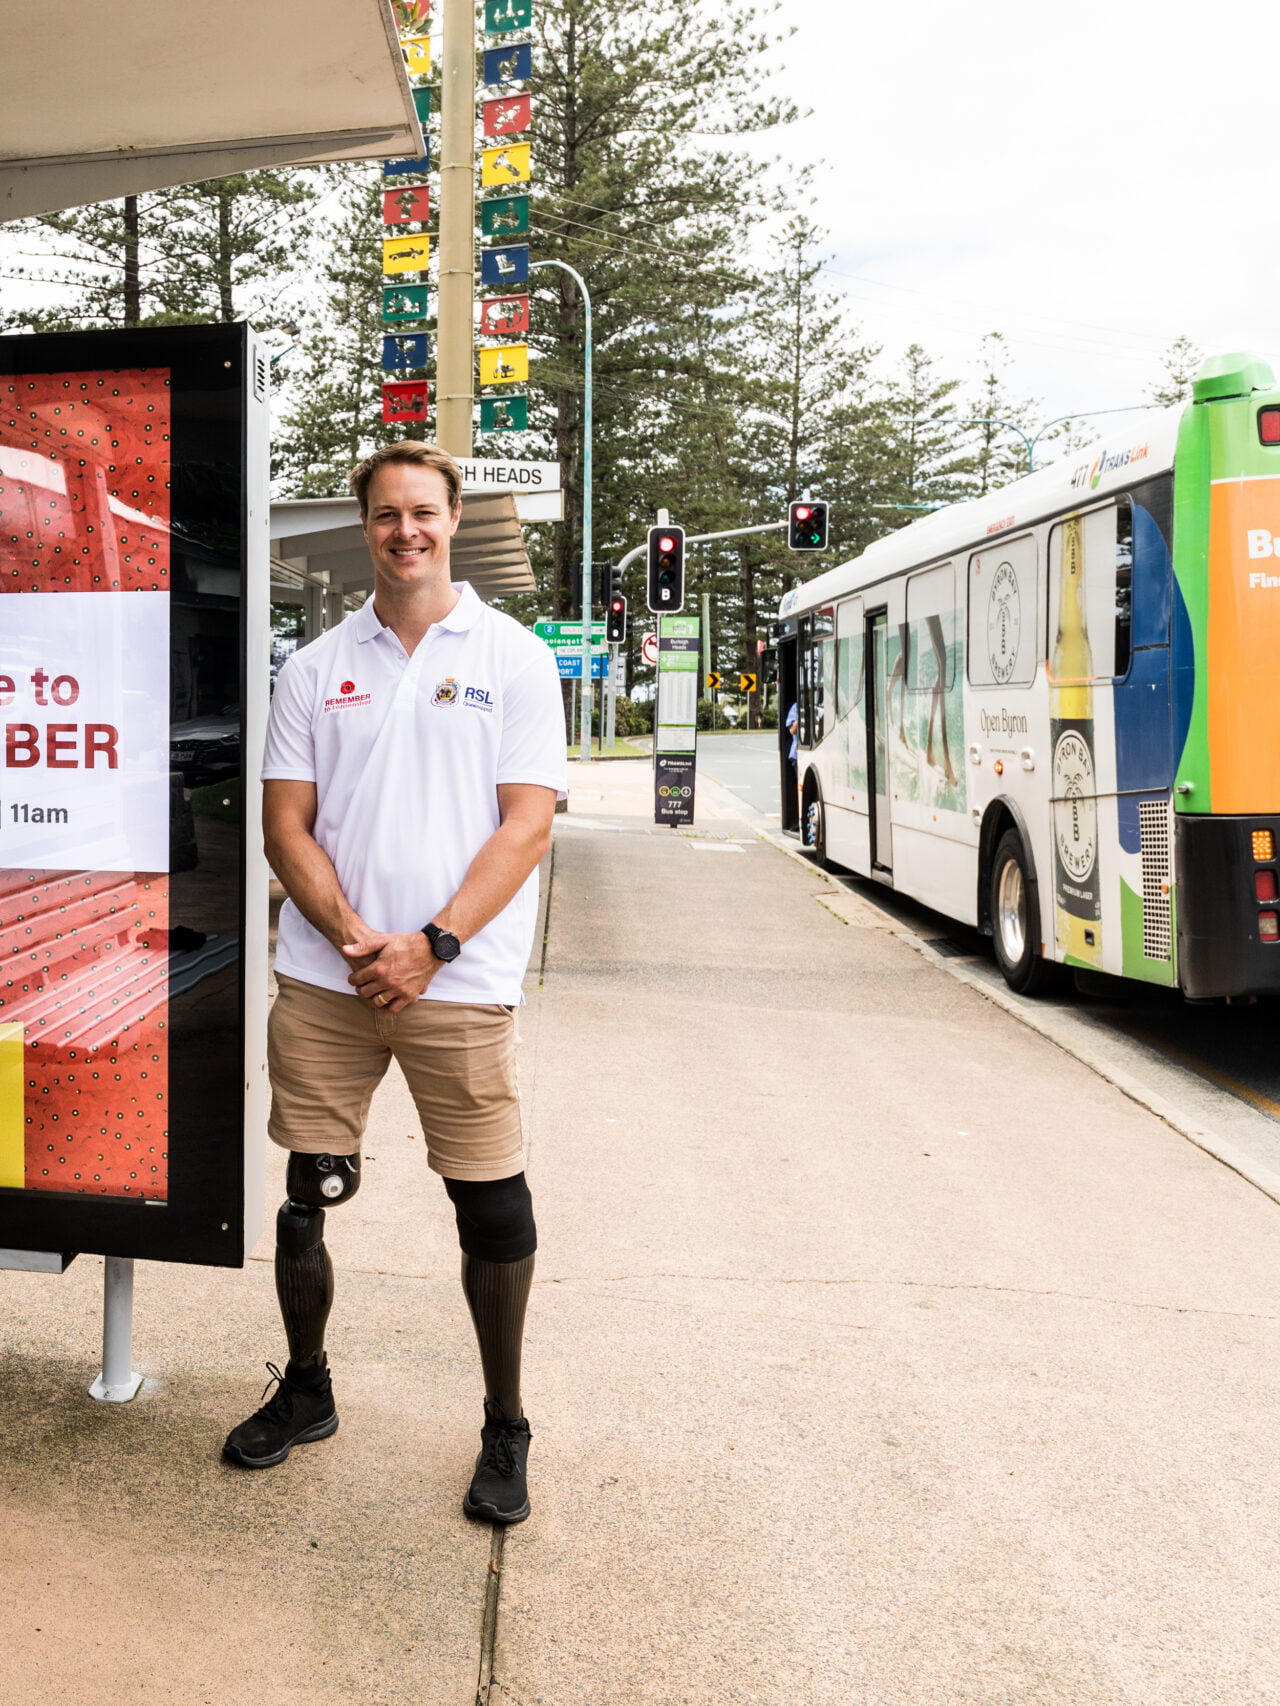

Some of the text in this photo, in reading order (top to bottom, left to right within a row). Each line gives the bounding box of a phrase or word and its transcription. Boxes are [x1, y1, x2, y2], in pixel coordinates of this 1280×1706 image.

[483, 466, 543, 485] HEADS
[30, 667, 80, 707] to
[464, 686, 494, 705] RSL
[324, 693, 371, 706] REMEMBER
[980, 708, 1028, 739] Open Byron
[10, 802, 69, 825] 11am
[668, 801, 682, 809] 777
